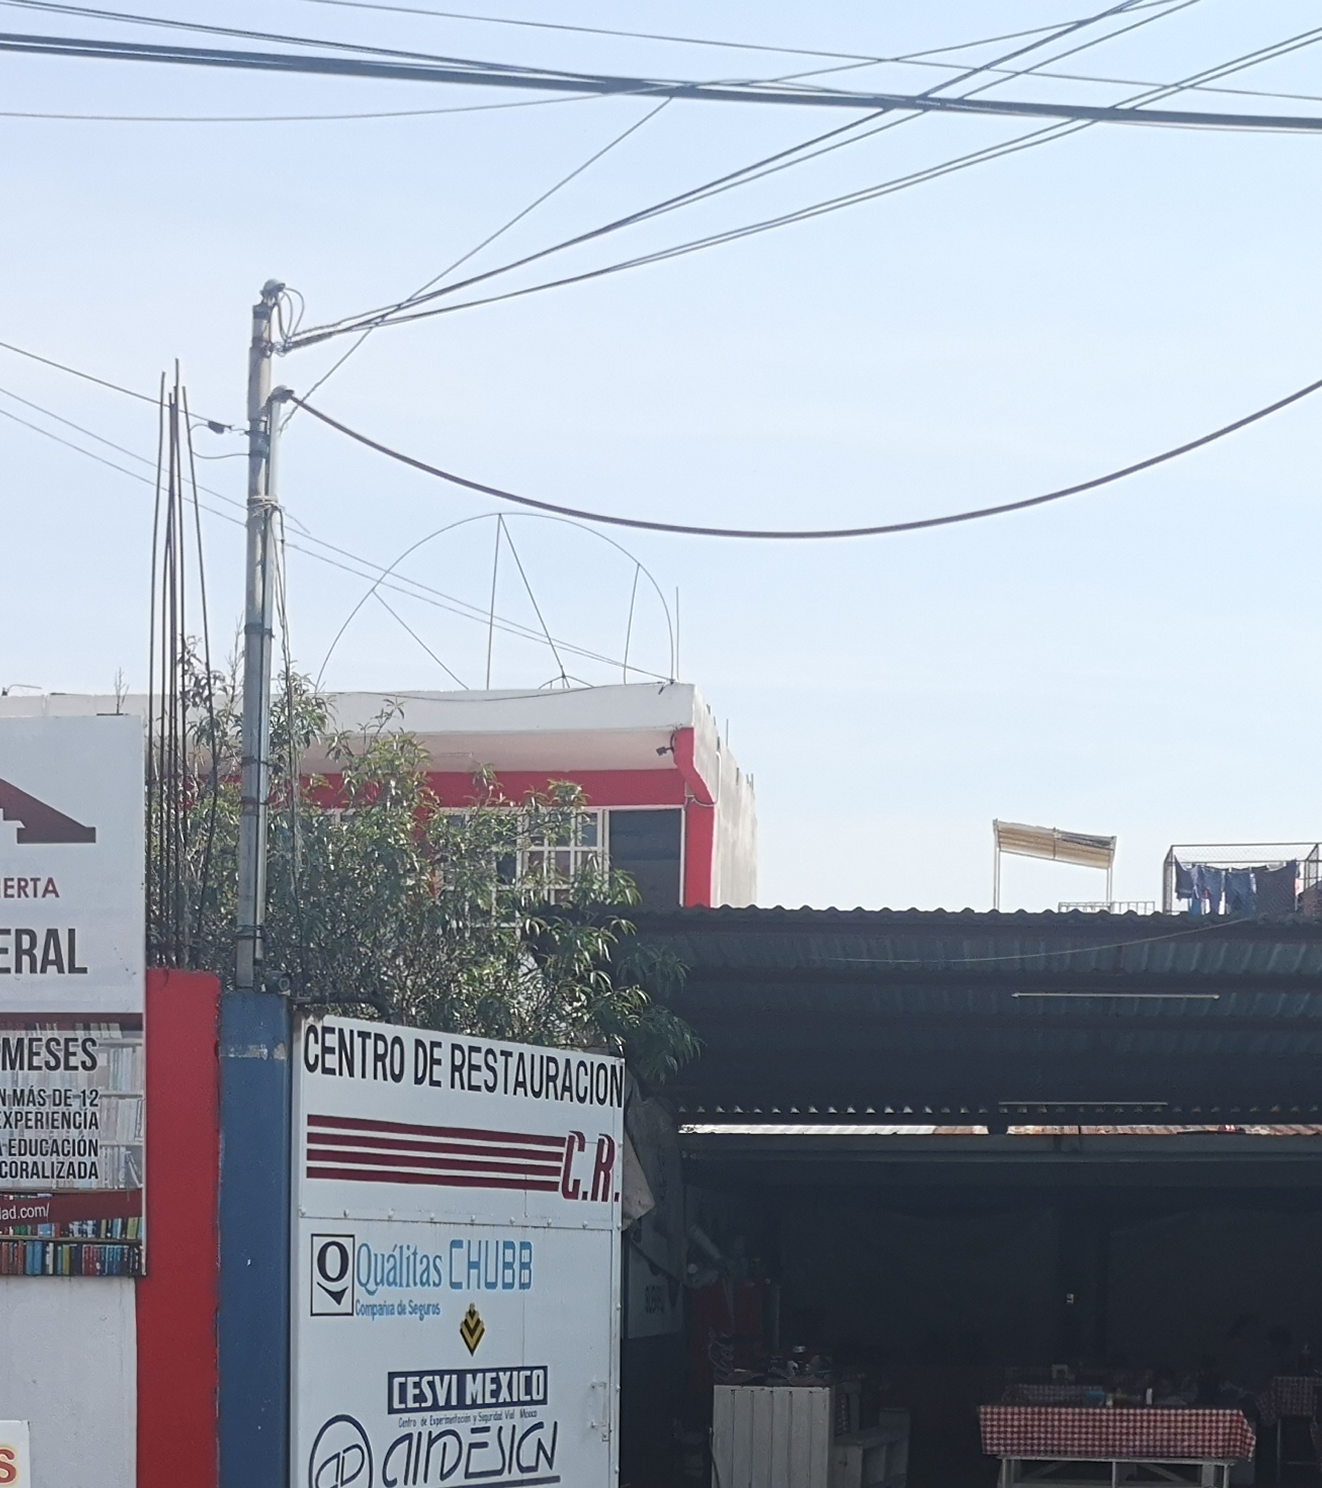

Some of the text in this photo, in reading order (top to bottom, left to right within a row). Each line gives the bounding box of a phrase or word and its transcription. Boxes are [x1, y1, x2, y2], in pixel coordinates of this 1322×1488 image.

[1, 1036, 98, 1071] MESES
[303, 1023, 624, 1109] CENTRO DE RESTAURACION
[12, 1085, 47, 1107] MÁS
[52, 1088, 73, 1107] DE
[81, 1088, 99, 1107] 12
[8, 1135, 99, 1158] EDUCACIÓN
[355, 1242, 443, 1296] Quálitas
[448, 1238, 534, 1291] CHUBB
[396, 1300, 408, 1316] de
[408, 1299, 442, 1322] Seguros
[392, 1369, 545, 1410] CESVI MEXICO
[398, 1416, 417, 1428] Centro
[420, 1415, 428, 1427] de
